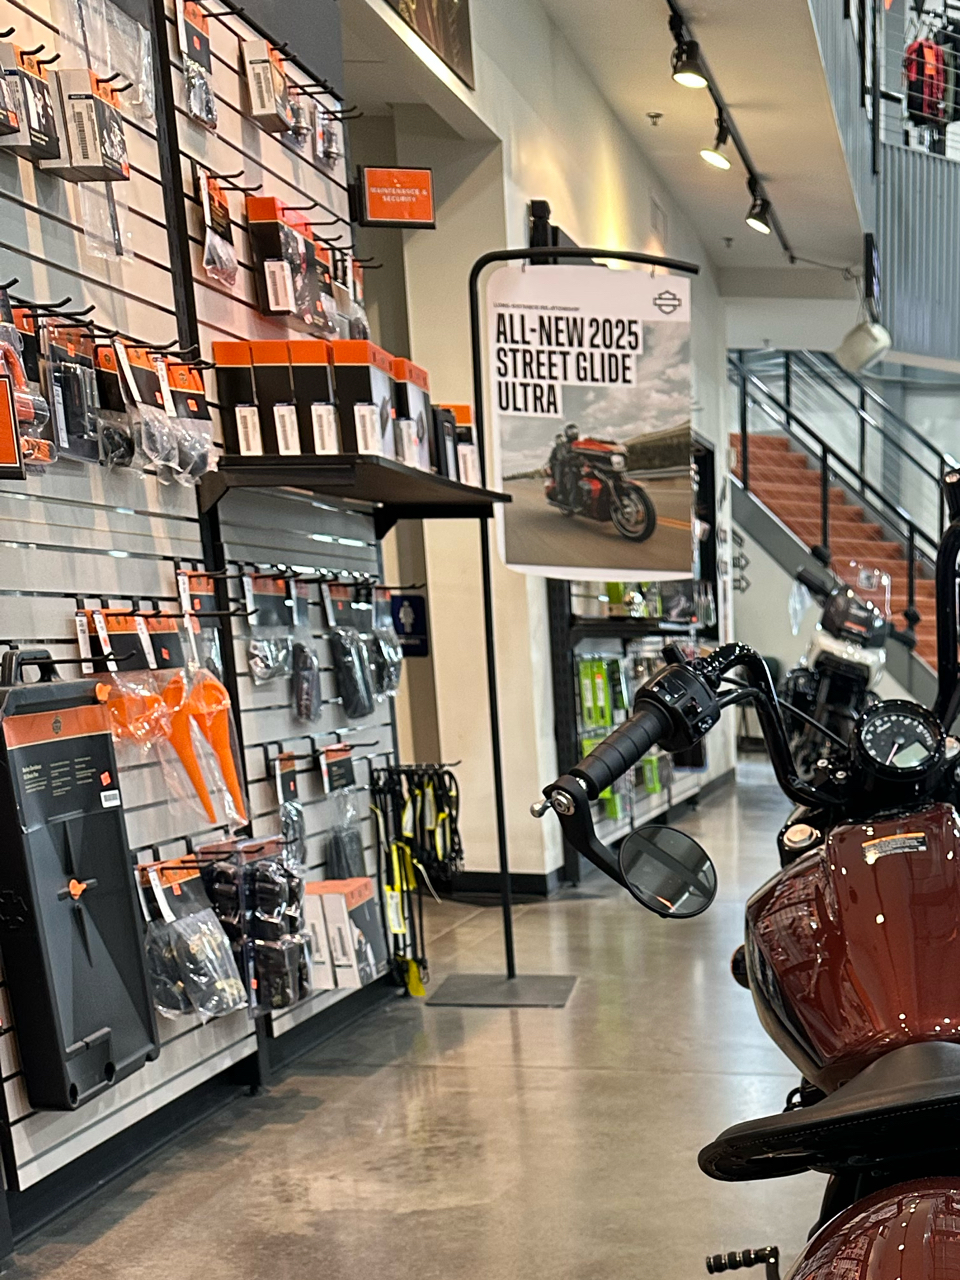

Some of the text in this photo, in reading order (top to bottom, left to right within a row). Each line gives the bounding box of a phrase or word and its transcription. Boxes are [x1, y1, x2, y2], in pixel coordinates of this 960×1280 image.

[496, 312, 639, 350] ALL-NEW 2025
[497, 347, 633, 384] STREET GLIDE
[497, 381, 559, 414] ULTRA
